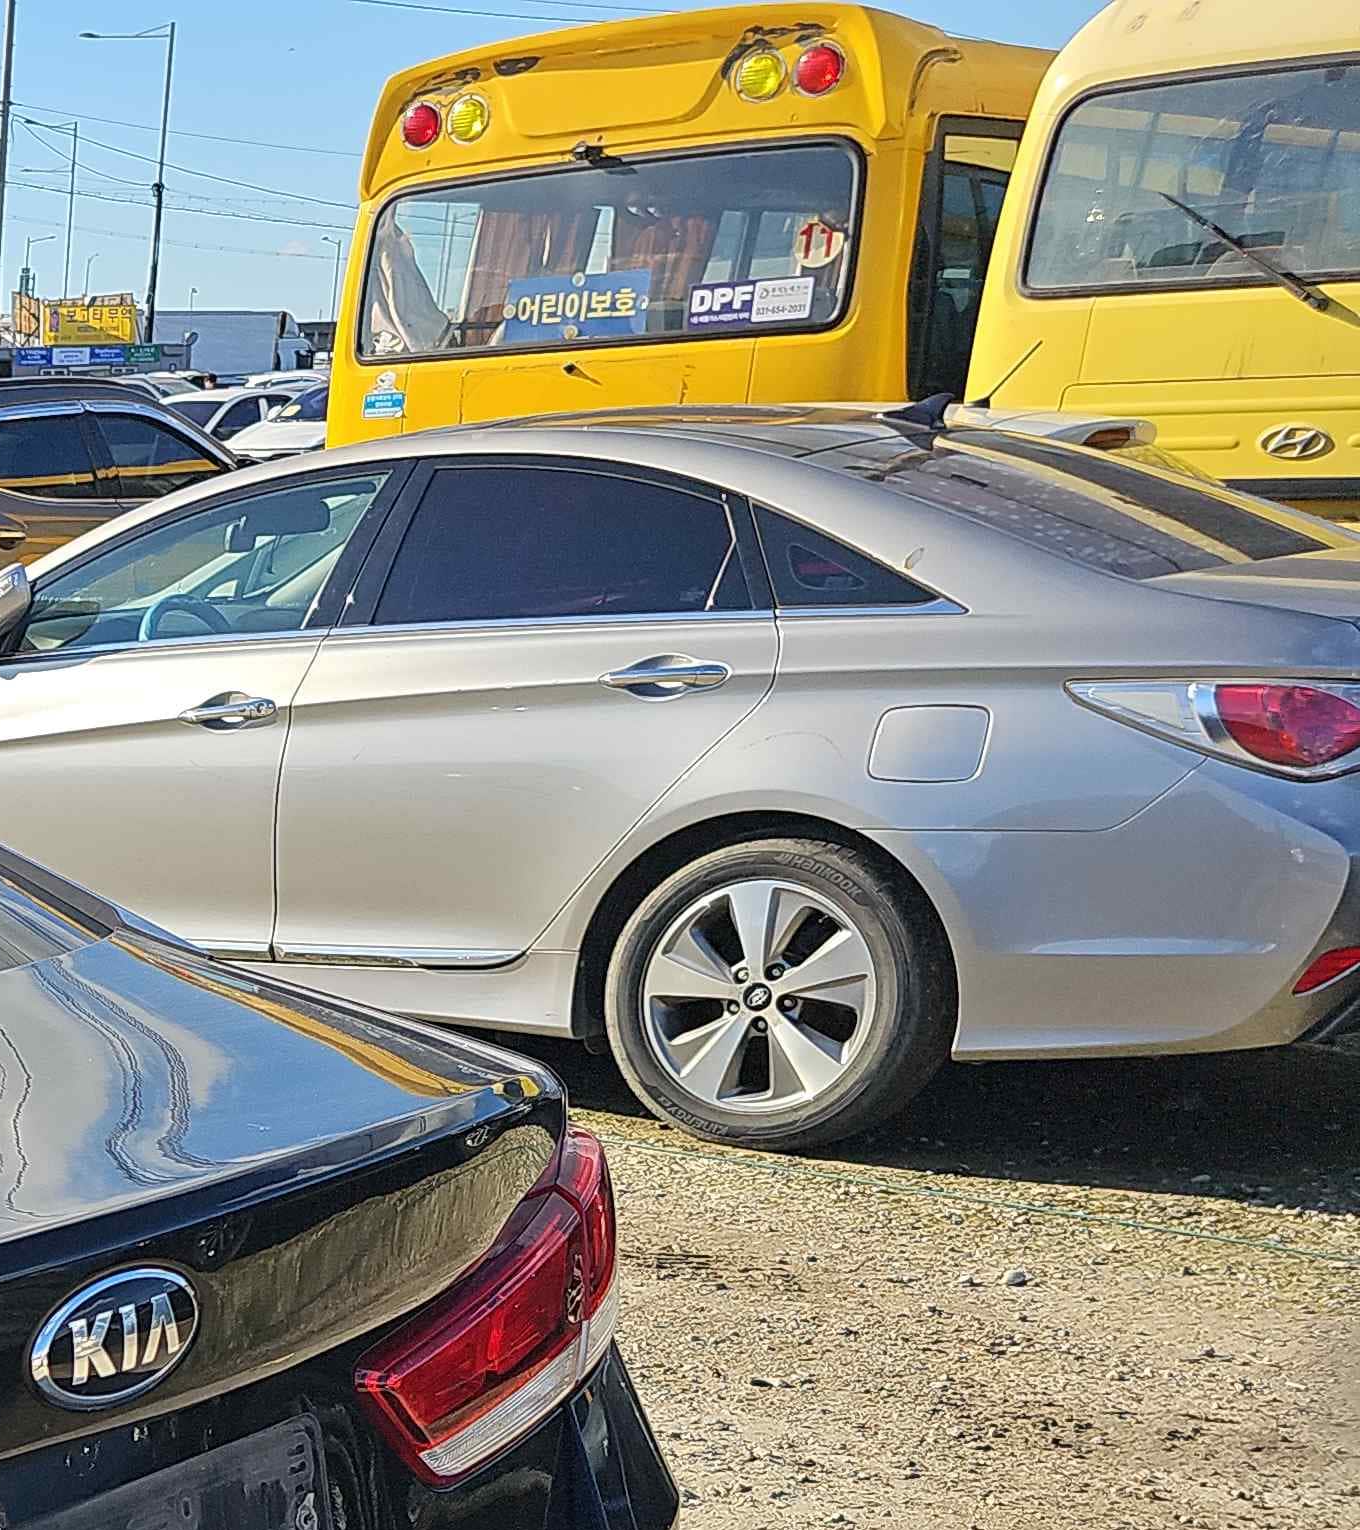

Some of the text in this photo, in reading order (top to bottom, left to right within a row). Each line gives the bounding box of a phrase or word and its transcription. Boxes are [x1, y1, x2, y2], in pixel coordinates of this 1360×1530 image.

[800, 222, 834, 260] 11
[517, 287, 637, 326] 어린이보호
[690, 285, 755, 314] DPF
[68, 1292, 181, 1386] KIA
